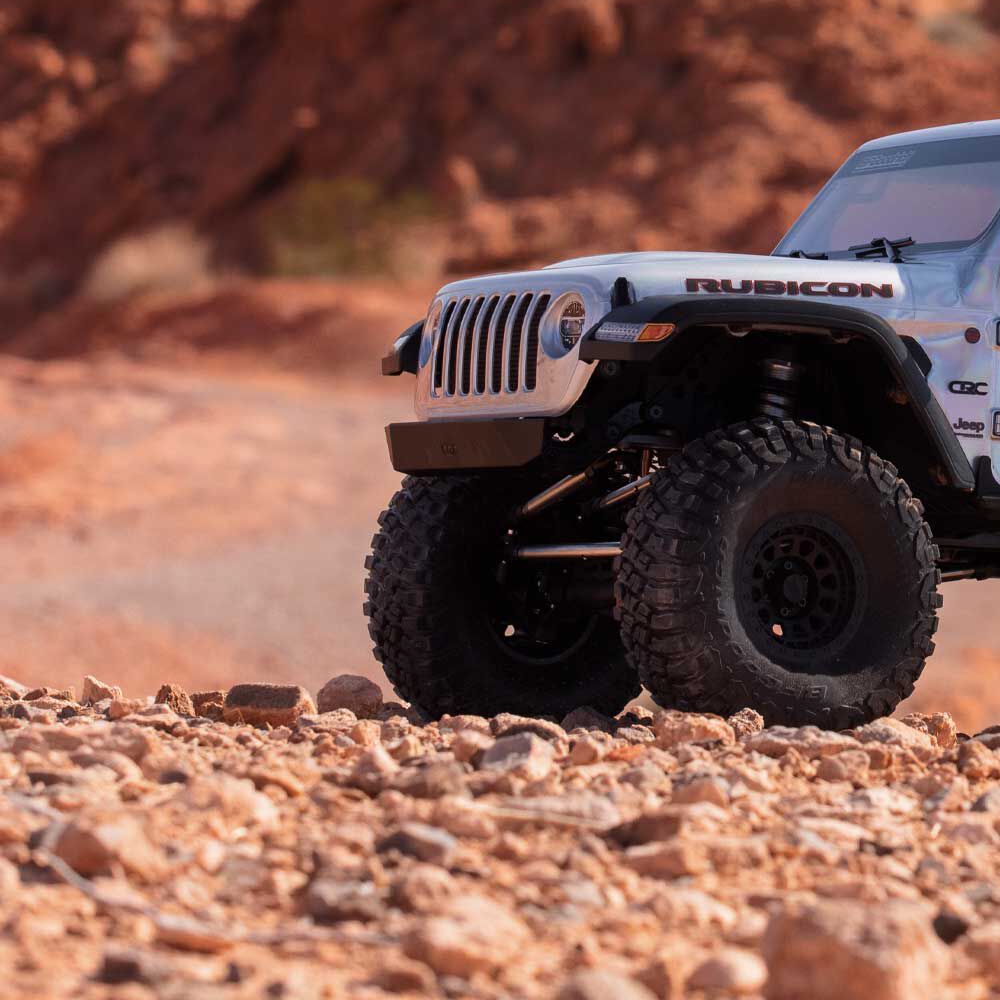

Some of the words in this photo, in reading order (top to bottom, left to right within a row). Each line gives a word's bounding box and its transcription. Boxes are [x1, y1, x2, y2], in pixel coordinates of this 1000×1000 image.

[685, 278, 894, 297] RUBICON
[948, 380, 988, 395] CRC
[953, 418, 985, 433] Jeep
